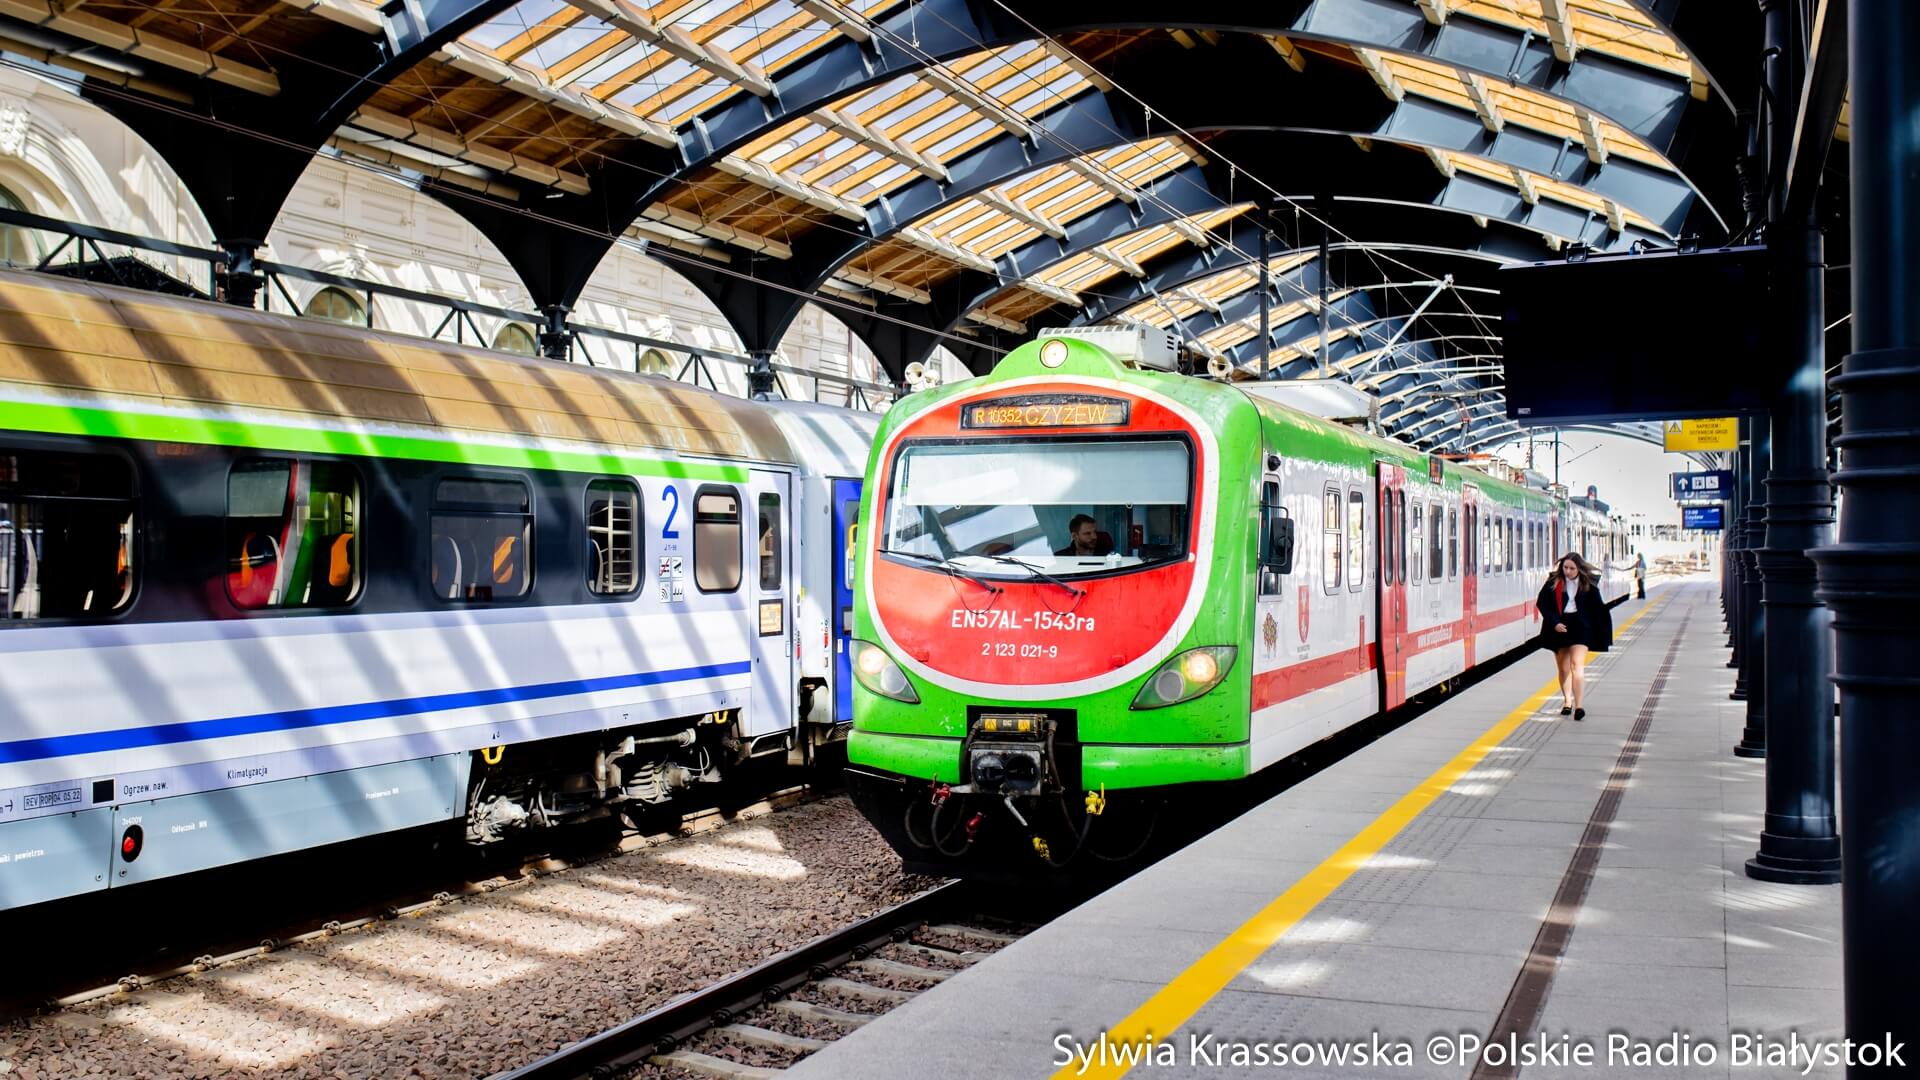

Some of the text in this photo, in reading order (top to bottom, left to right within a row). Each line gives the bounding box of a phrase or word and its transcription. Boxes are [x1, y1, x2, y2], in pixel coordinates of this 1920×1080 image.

[975, 409, 985, 424] R
[988, 408, 1023, 424] 10352
[662, 484, 679, 539] 2
[951, 609, 1096, 631] EN57AL-1543ra
[981, 642, 1058, 658] 2 123 021-9
[227, 765, 268, 780] Klimatyzacja
[26, 796, 38, 808] REV
